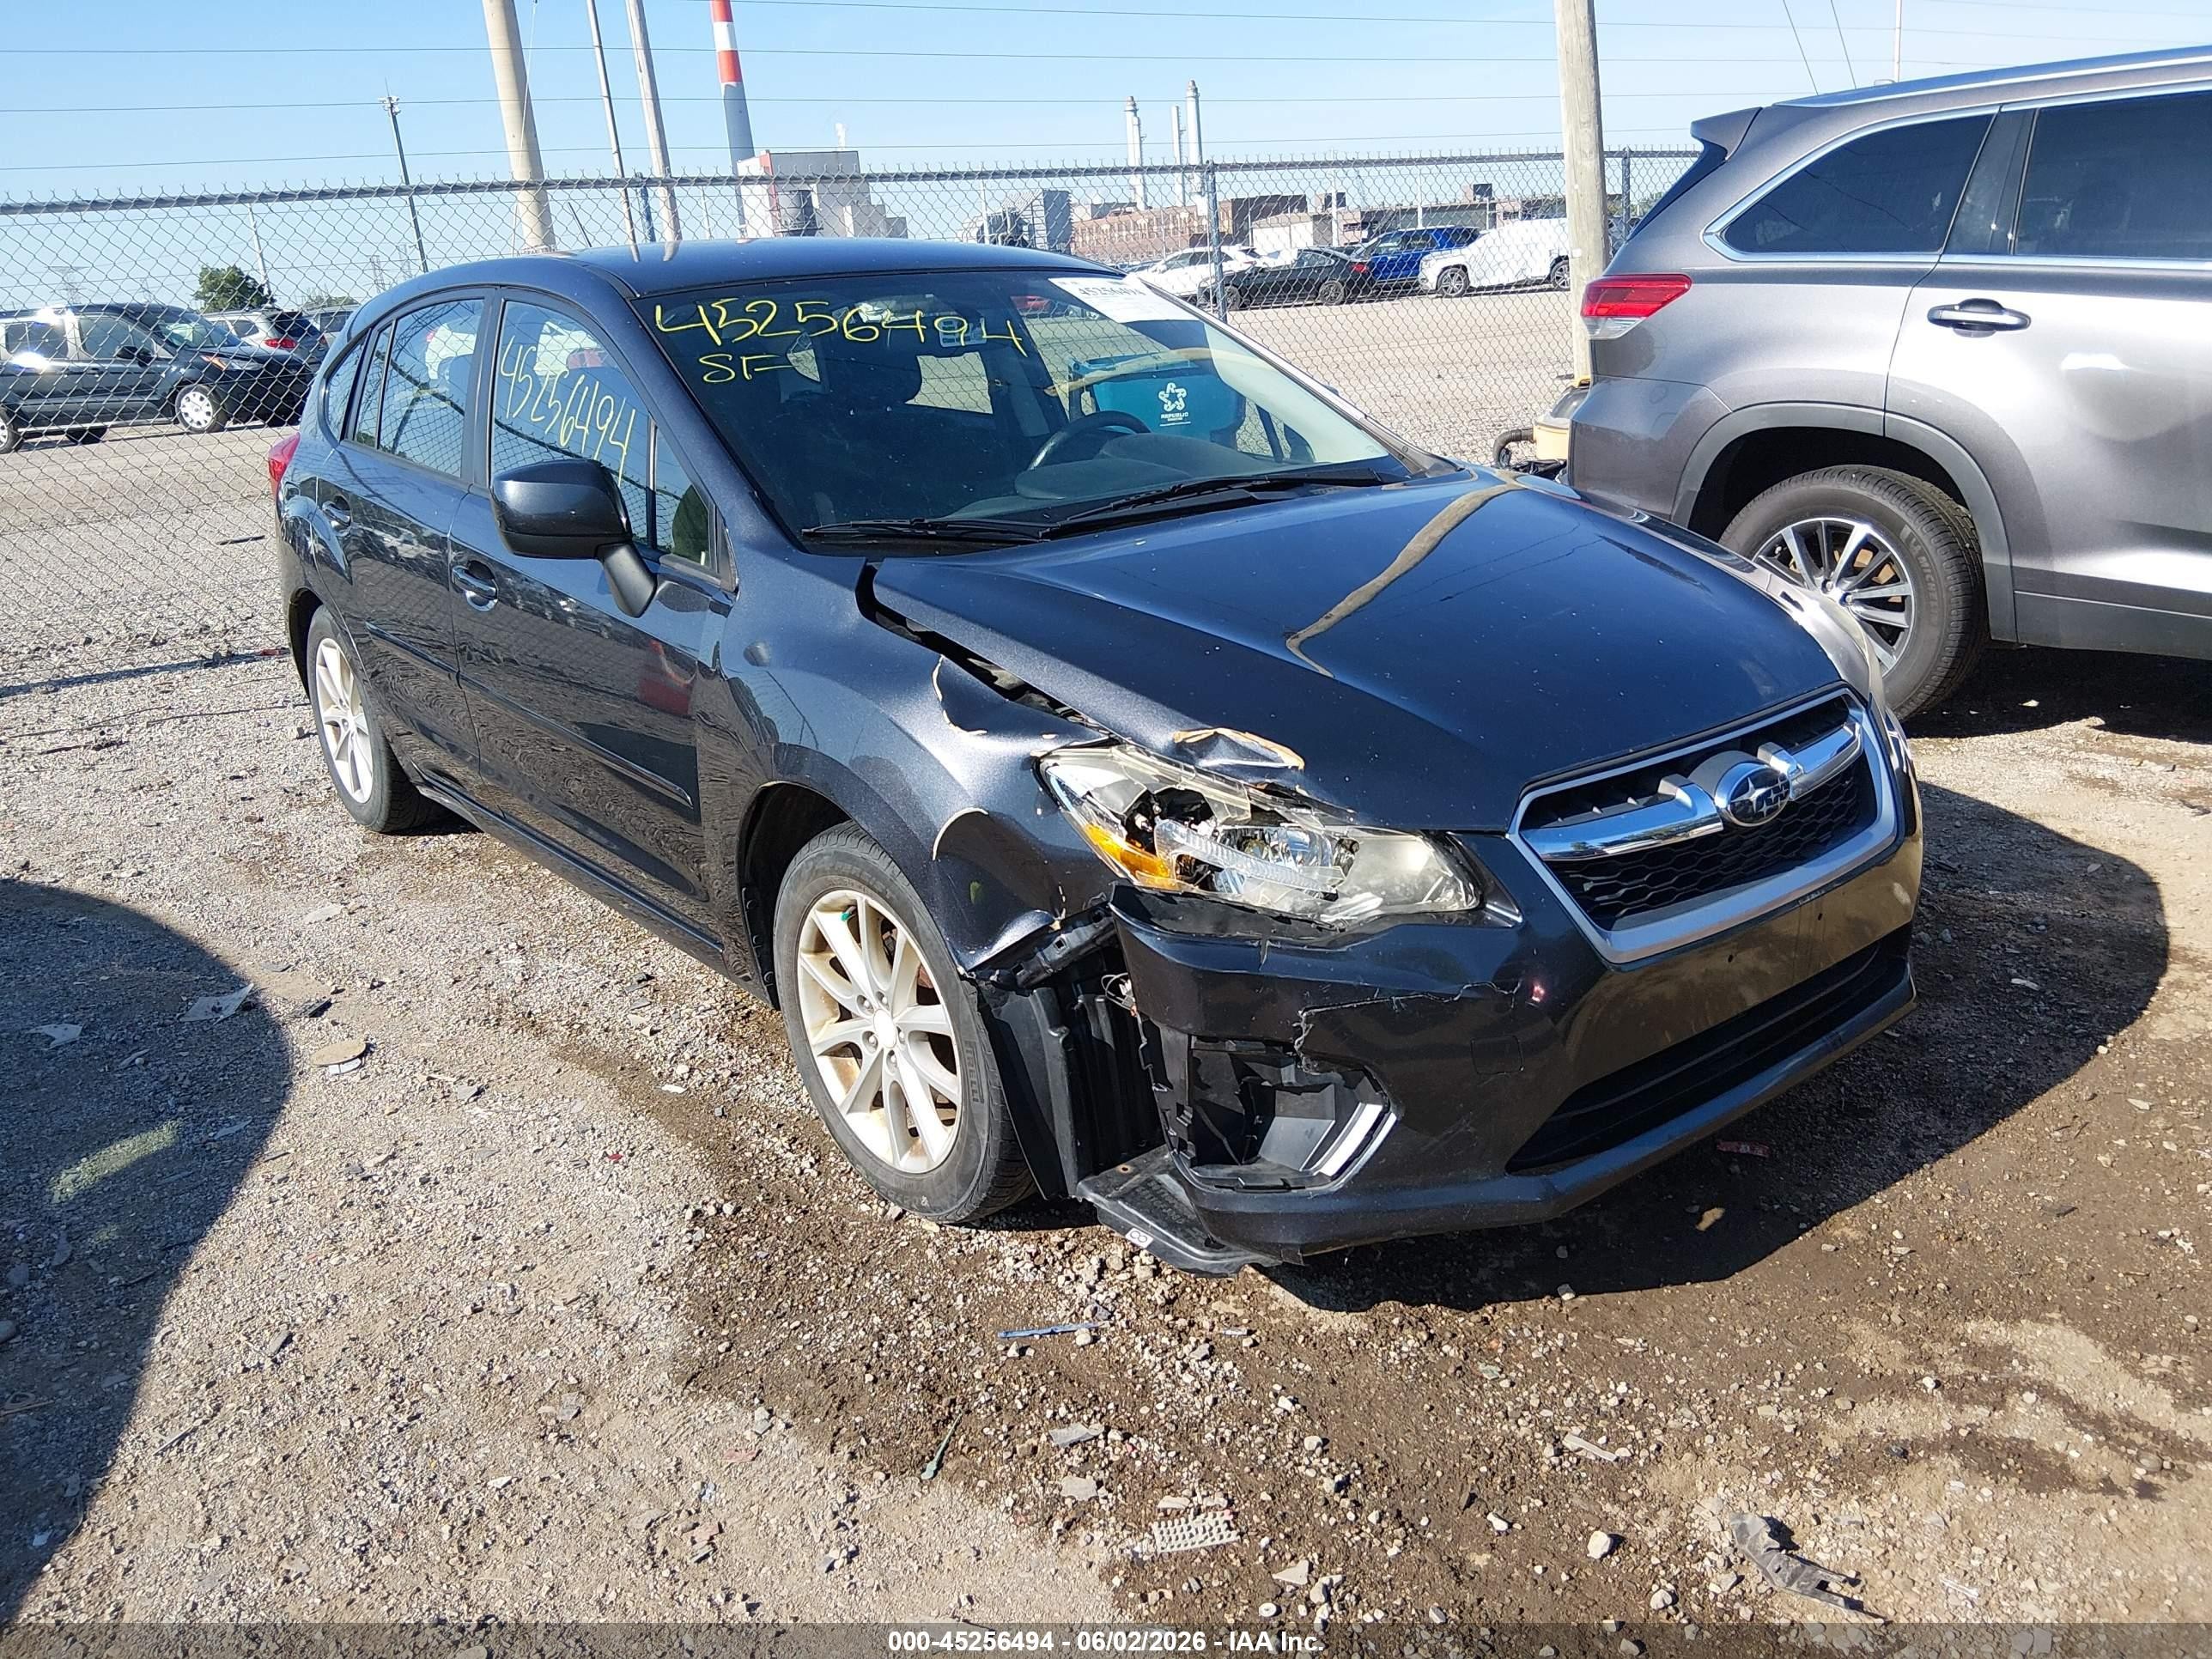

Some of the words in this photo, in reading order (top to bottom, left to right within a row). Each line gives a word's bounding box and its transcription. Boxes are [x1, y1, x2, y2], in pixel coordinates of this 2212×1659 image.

[655, 298, 1028, 357] 45256494
[698, 353, 796, 383] SF
[501, 335, 636, 487] 45256494
[963, 1040, 985, 1103] PIRELLI
